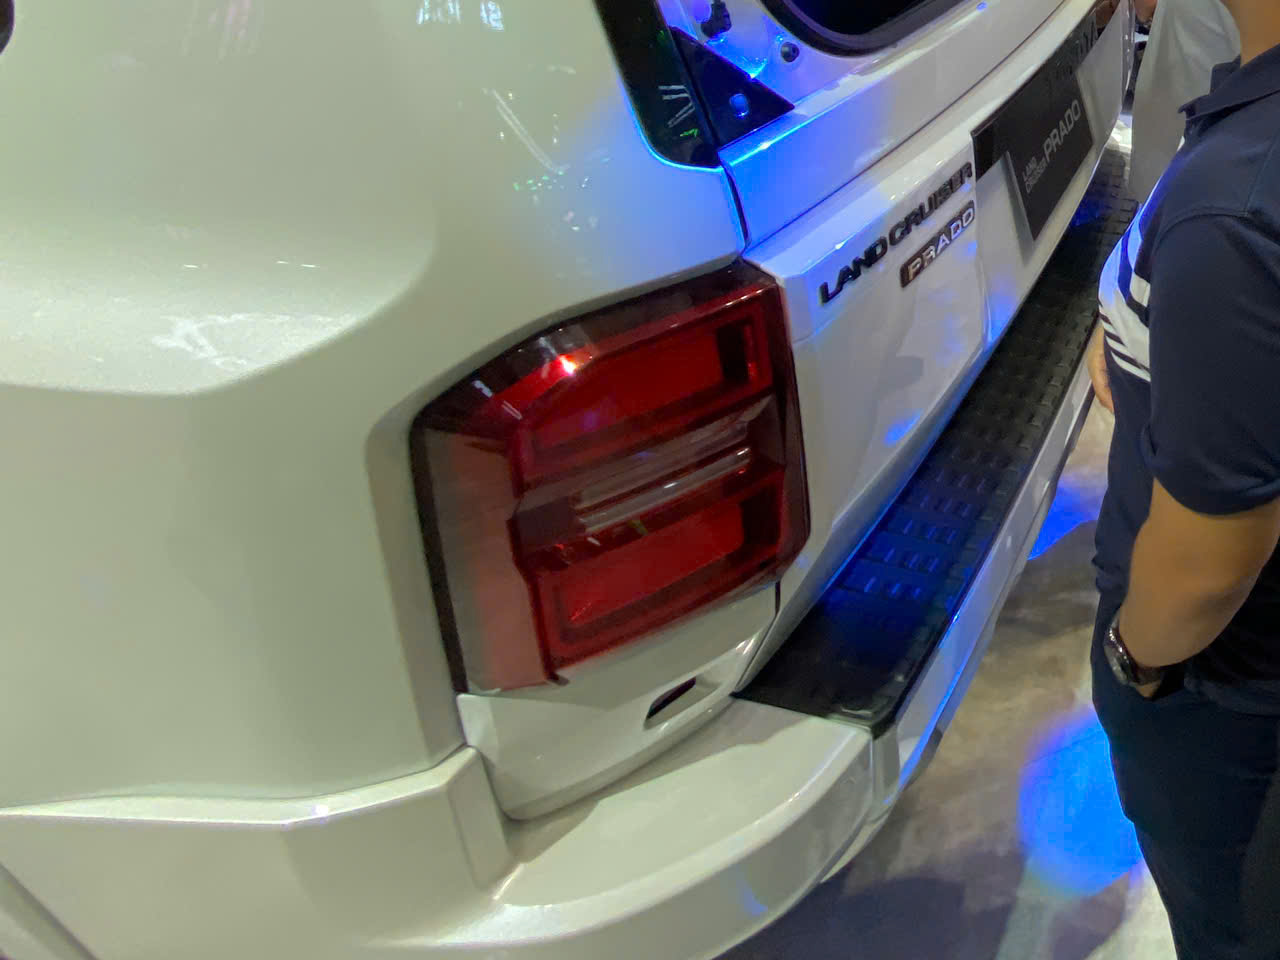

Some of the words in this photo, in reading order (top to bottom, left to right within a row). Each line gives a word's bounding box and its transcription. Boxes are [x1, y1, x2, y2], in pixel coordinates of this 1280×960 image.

[1043, 99, 1081, 162] PRADO
[819, 236, 888, 304] LAND
[889, 161, 973, 246] CRUISER
[907, 206, 975, 282] PRADO
